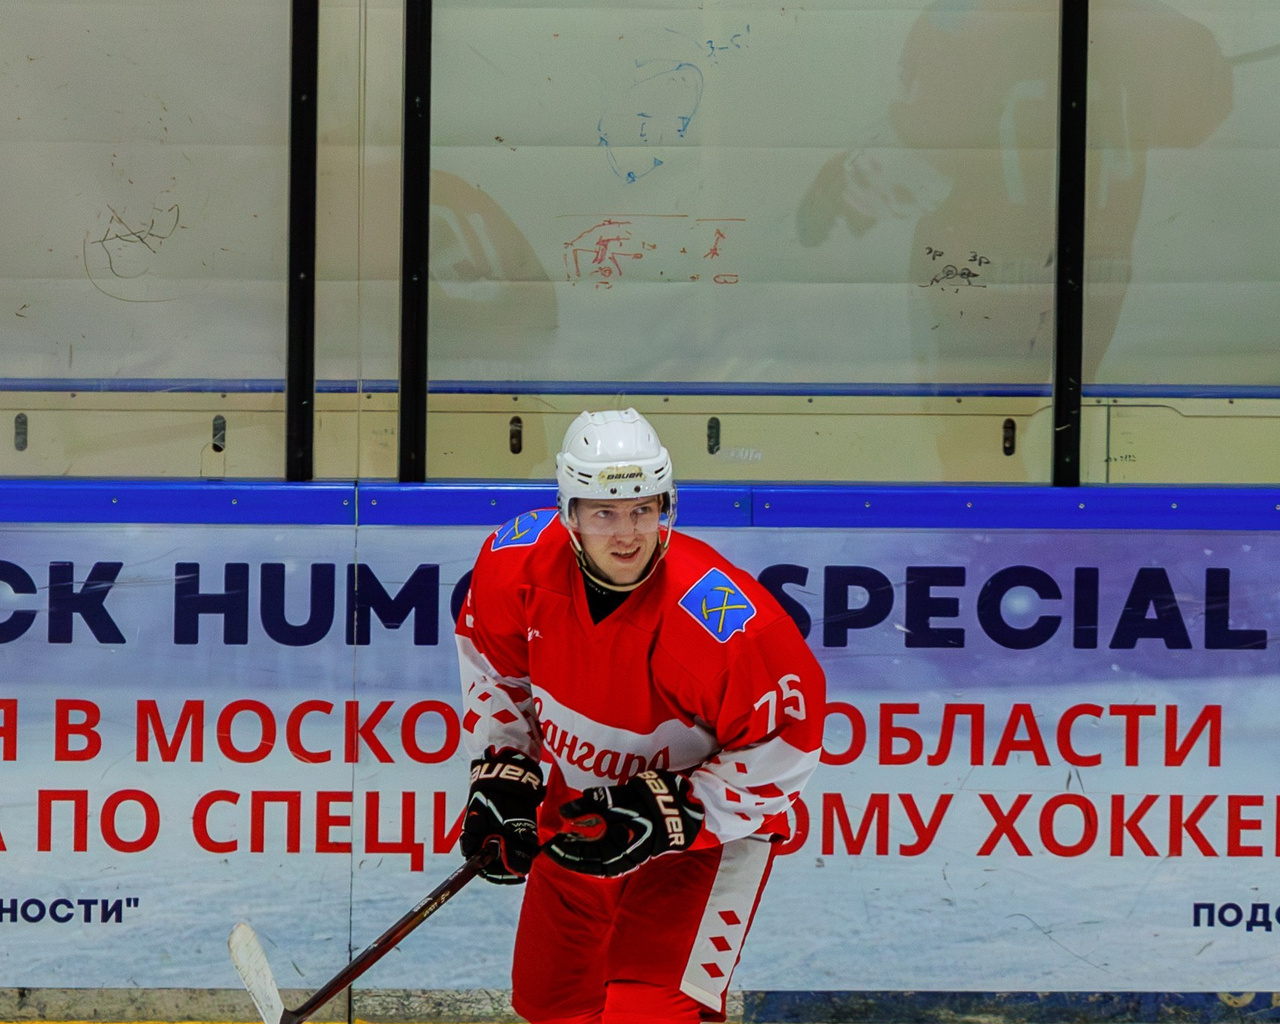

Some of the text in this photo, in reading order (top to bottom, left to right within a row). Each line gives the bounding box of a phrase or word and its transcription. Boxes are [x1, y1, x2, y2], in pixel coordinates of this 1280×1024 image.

[174, 562, 478, 647] HUM
[757, 563, 1268, 651] SPECIAL
[55, 699, 102, 762] В
[819, 702, 1222, 767] ОБЛАСТИ
[753, 674, 806, 733] 75
[37, 789, 160, 853] ПО
[637, 770, 685, 847] BAUER
